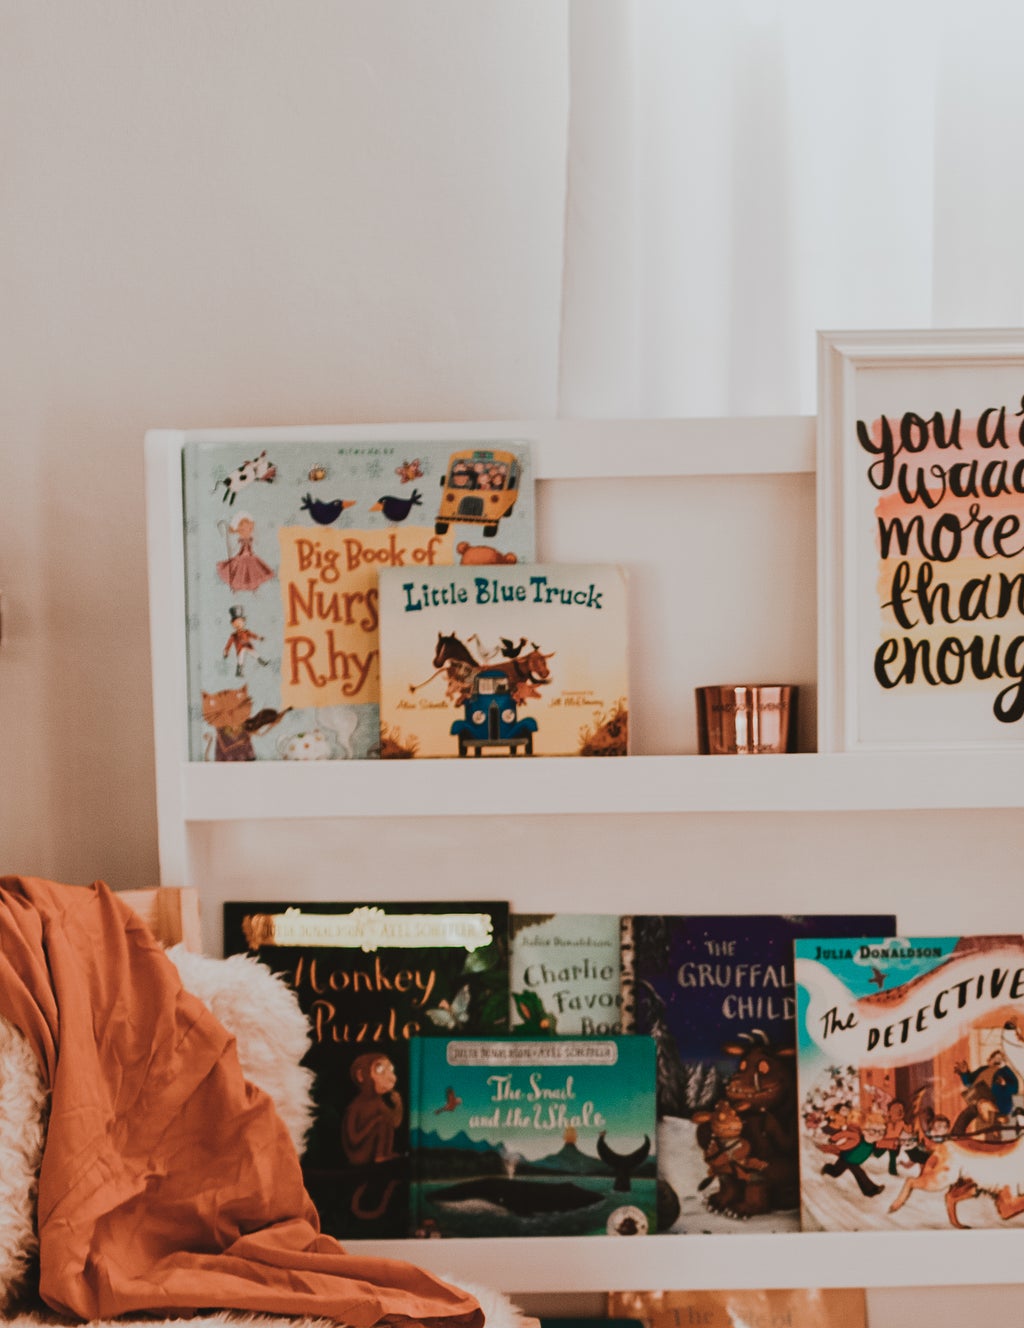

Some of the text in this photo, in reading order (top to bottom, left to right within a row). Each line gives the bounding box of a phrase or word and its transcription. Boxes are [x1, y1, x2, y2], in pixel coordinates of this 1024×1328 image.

[857, 408, 961, 489] you
[294, 534, 443, 583] Big Book of
[403, 576, 603, 612] Little Blue Truck
[285, 629, 379, 697] Rhy
[704, 940, 736, 957] THE
[815, 945, 942, 960] JULIA DONALDSON
[523, 958, 614, 987] Charlie
[677, 962, 795, 988] GRUFFAL
[820, 1006, 858, 1039] The
[486, 1072, 576, 1102] The Snail
[469, 1101, 606, 1130] and the Whale
